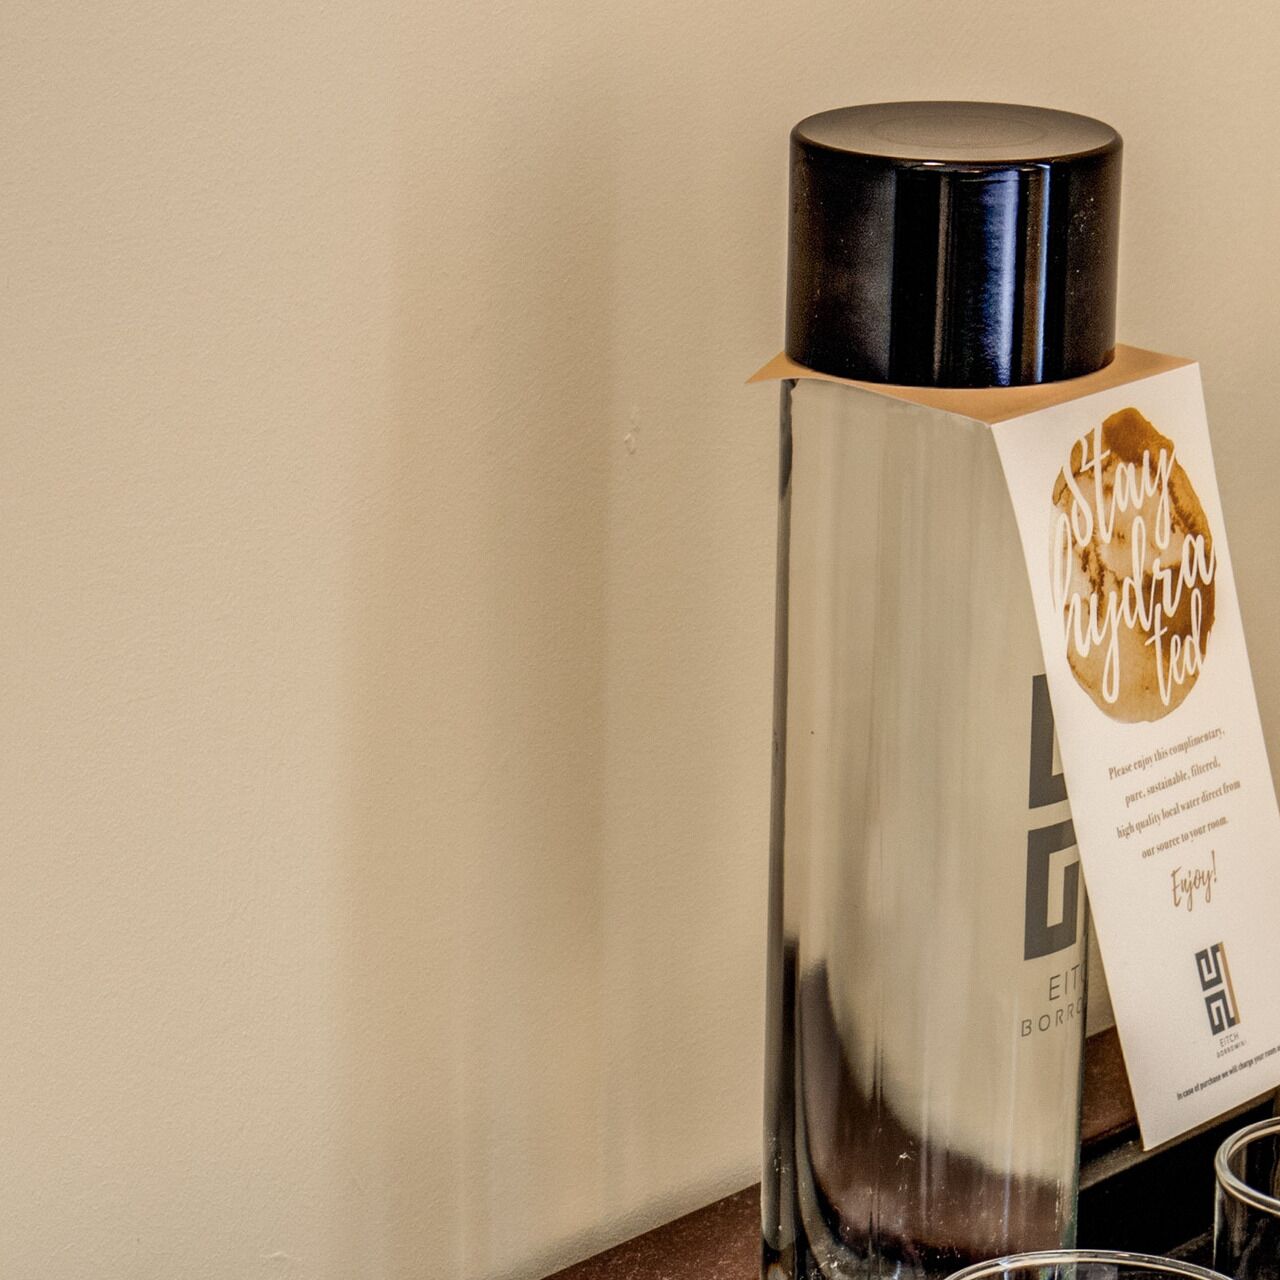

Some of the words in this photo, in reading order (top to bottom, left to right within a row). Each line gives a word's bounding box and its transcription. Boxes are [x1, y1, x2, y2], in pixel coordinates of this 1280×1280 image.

[1108, 763, 1132, 780] Please
[1133, 756, 1153, 771] enjoy
[1154, 747, 1169, 762] this
[1169, 727, 1225, 756] complimentary,
[1125, 791, 1146, 808] pure,
[1147, 770, 1191, 796] sustainable,
[1191, 755, 1221, 777] filtered,
[1116, 822, 1135, 839] high
[1135, 812, 1162, 834] quality
[1161, 802, 1180, 820] local
[1180, 796, 1201, 812] water
[1201, 787, 1223, 803] direct
[1223, 780, 1241, 794] from
[1142, 847, 1155, 859] our
[1156, 836, 1181, 852] source
[1181, 832, 1190, 842] to
[1189, 824, 1208, 842] your
[1207, 816, 1229, 832] room.
[1171, 849, 1217, 912] Enjoy!
